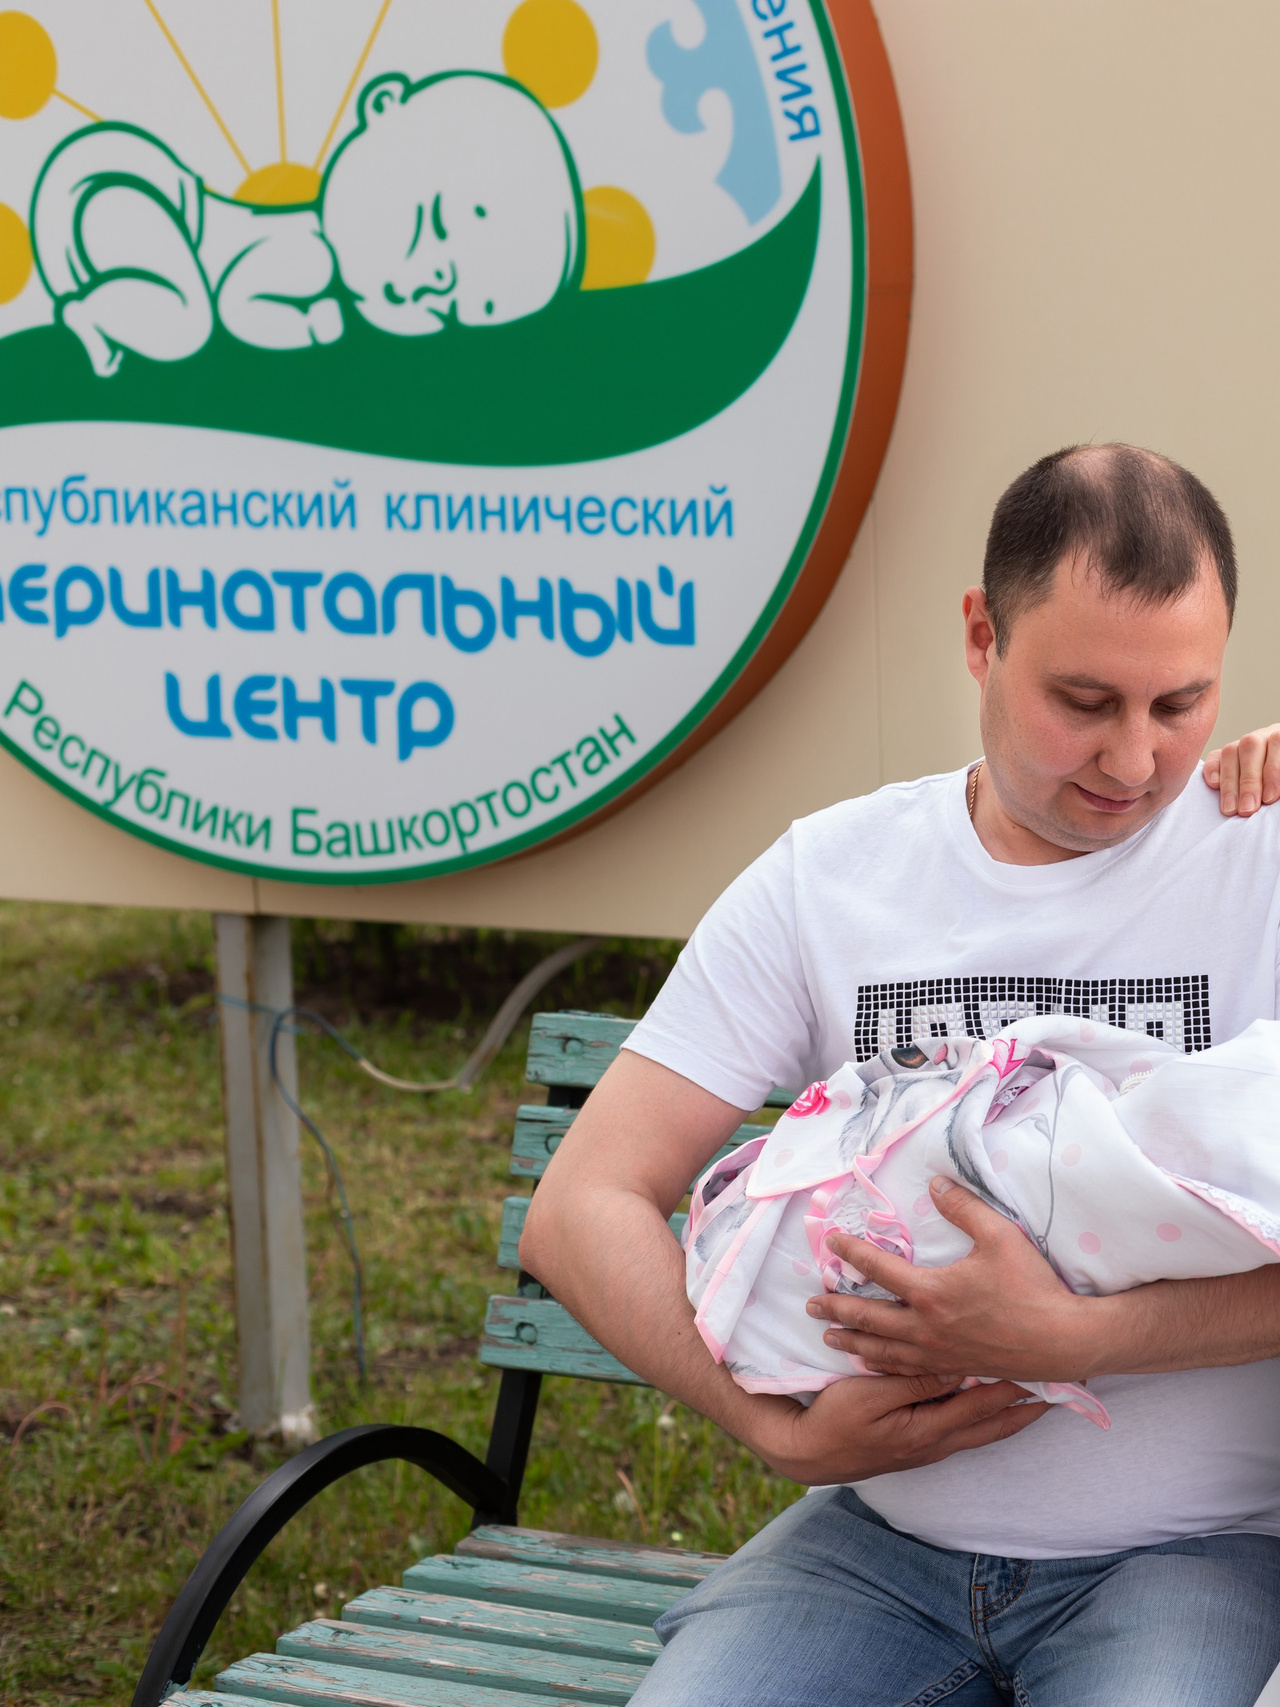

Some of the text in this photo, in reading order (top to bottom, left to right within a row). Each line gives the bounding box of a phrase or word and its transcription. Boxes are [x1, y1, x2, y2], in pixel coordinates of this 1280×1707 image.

[0, 473, 734, 539] публиканский клинический
[2, 678, 638, 860] Республики Башкортостан
